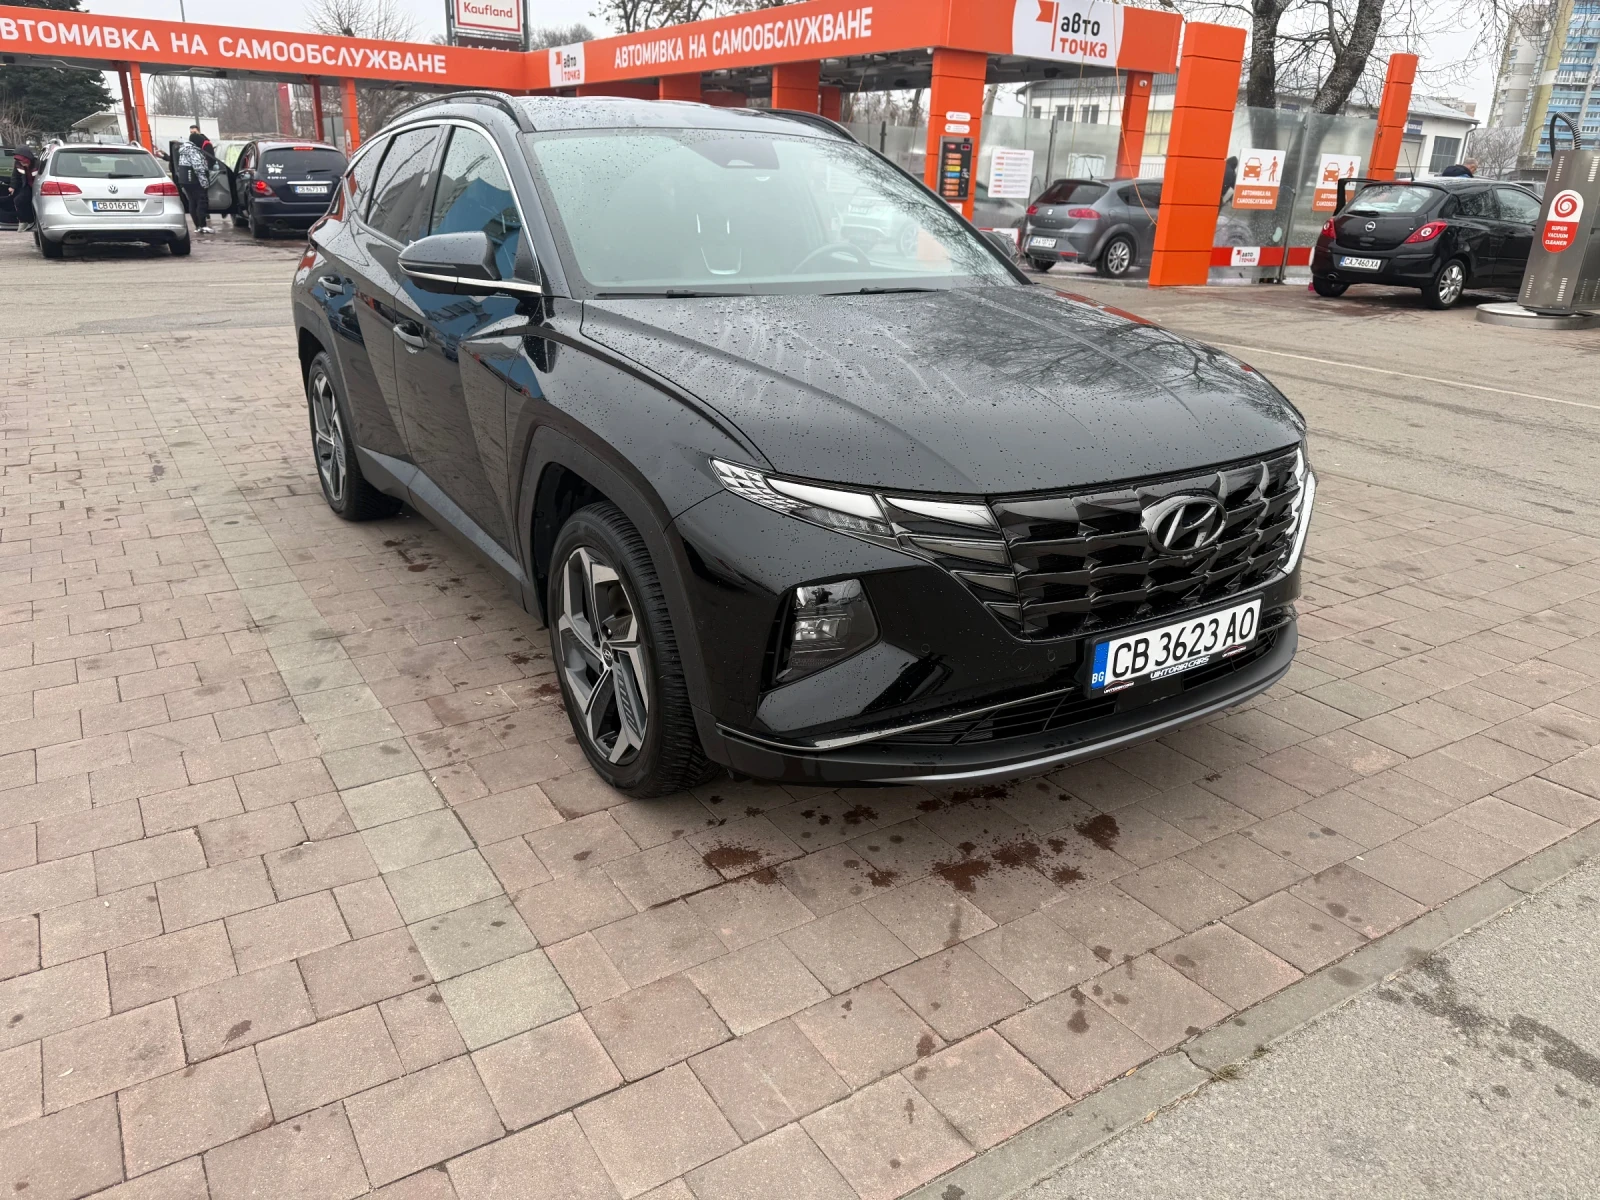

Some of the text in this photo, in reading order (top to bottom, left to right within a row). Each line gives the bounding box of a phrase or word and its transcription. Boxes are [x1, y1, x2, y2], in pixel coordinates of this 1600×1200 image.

[463, 2, 513, 18] Kaufland
[0, 17, 447, 74] ВТОМИВКА НА САМООБСЛУЖВАНЕ
[614, 6, 873, 69] АВТОМИВКА НА САМООБСЛУЖВАНЕ
[1060, 37, 1107, 58] точка
[1154, 618, 1220, 666] 3623
[1092, 672, 1104, 684] BG
